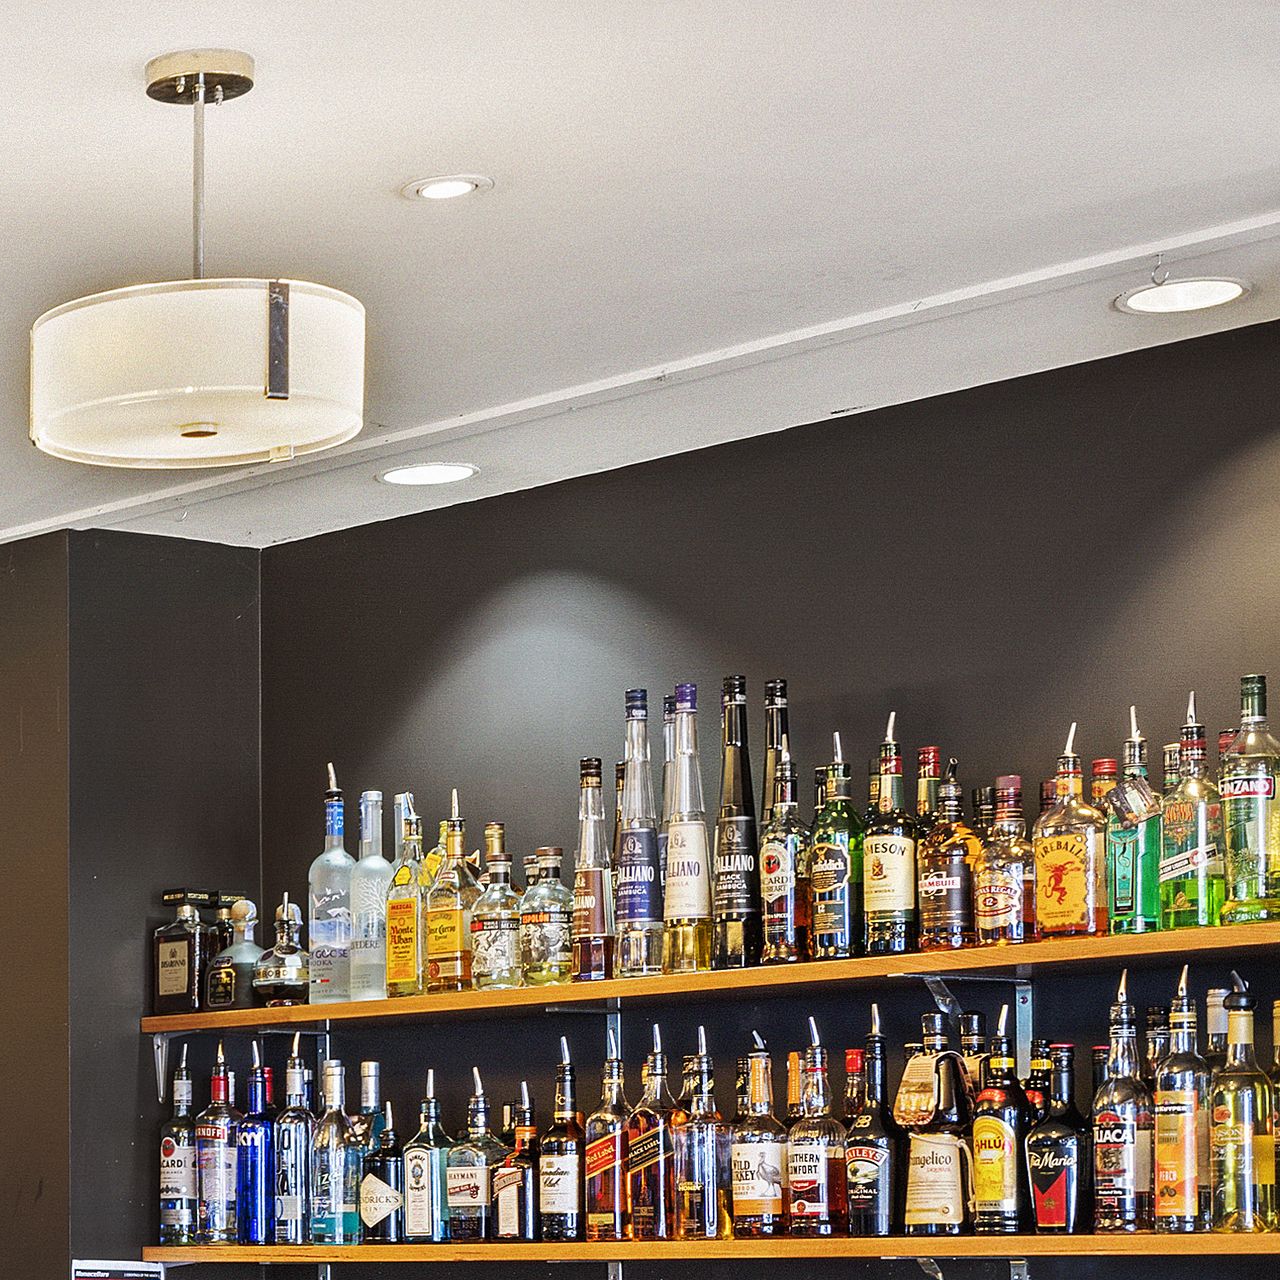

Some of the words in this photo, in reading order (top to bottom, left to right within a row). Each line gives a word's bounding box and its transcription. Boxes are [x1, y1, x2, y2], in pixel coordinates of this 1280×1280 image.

[668, 861, 701, 878] LLIANO
[574, 896, 596, 909] LLIANO
[196, 1126, 225, 1139] RNOFF
[790, 1153, 820, 1164] UTHERN
[910, 1151, 952, 1168] angelico
